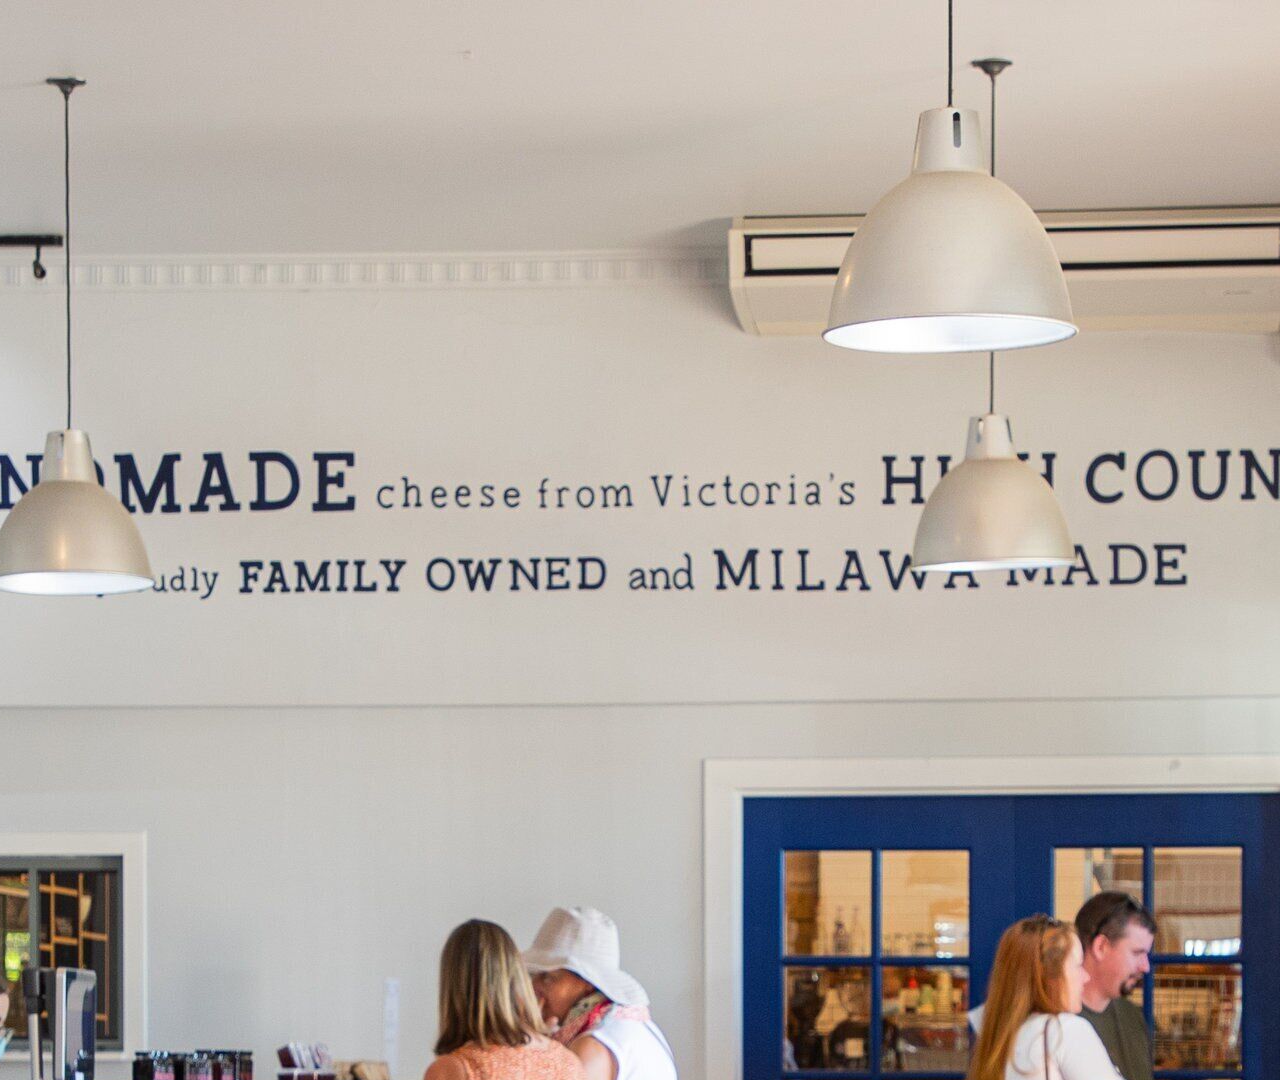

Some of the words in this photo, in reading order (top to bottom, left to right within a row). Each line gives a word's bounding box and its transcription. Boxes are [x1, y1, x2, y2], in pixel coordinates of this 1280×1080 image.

[376, 477, 521, 509] cheese
[538, 478, 634, 509] from
[650, 473, 856, 507] Victoria's
[238, 559, 408, 594] FAMILY
[425, 557, 608, 592] OWNED
[629, 553, 695, 591] and
